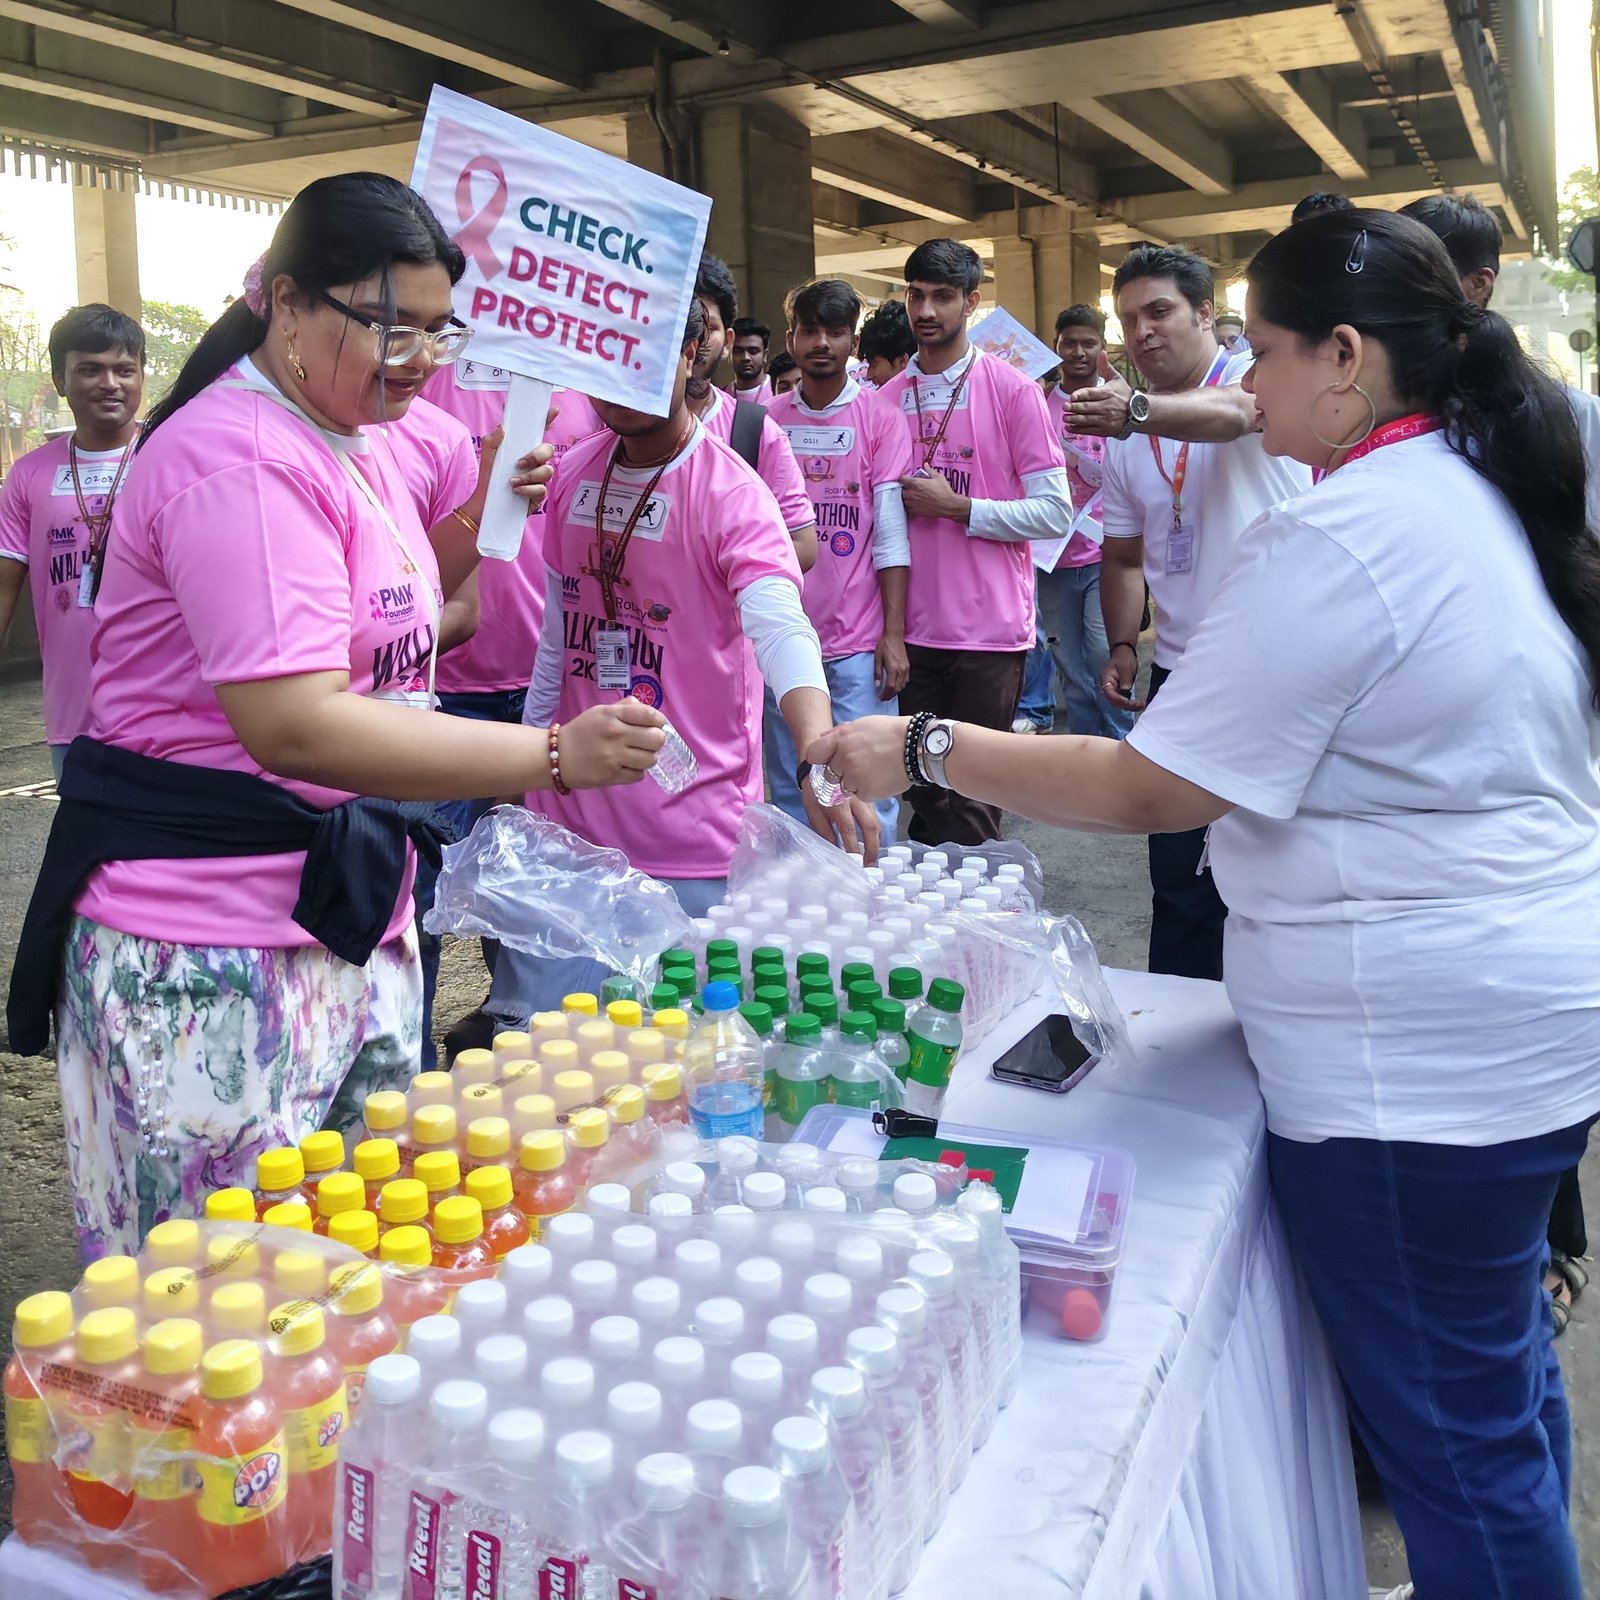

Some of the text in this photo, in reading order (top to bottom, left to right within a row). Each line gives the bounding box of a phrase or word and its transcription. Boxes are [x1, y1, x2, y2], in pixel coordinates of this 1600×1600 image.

[519, 197, 654, 274] CHECK.
[507, 246, 650, 325] DETECT.
[470, 287, 642, 370] PROTECT.
[813, 502, 859, 531] ATHON
[816, 530, 829, 542] 26
[379, 583, 414, 609] PMK
[562, 575, 581, 593] MK
[570, 658, 597, 682] 2K
[318, 1412, 342, 1447] POP
[234, 1454, 280, 1507] POP
[346, 1468, 366, 1543] Reeal
[409, 1496, 431, 1575] Reeal
